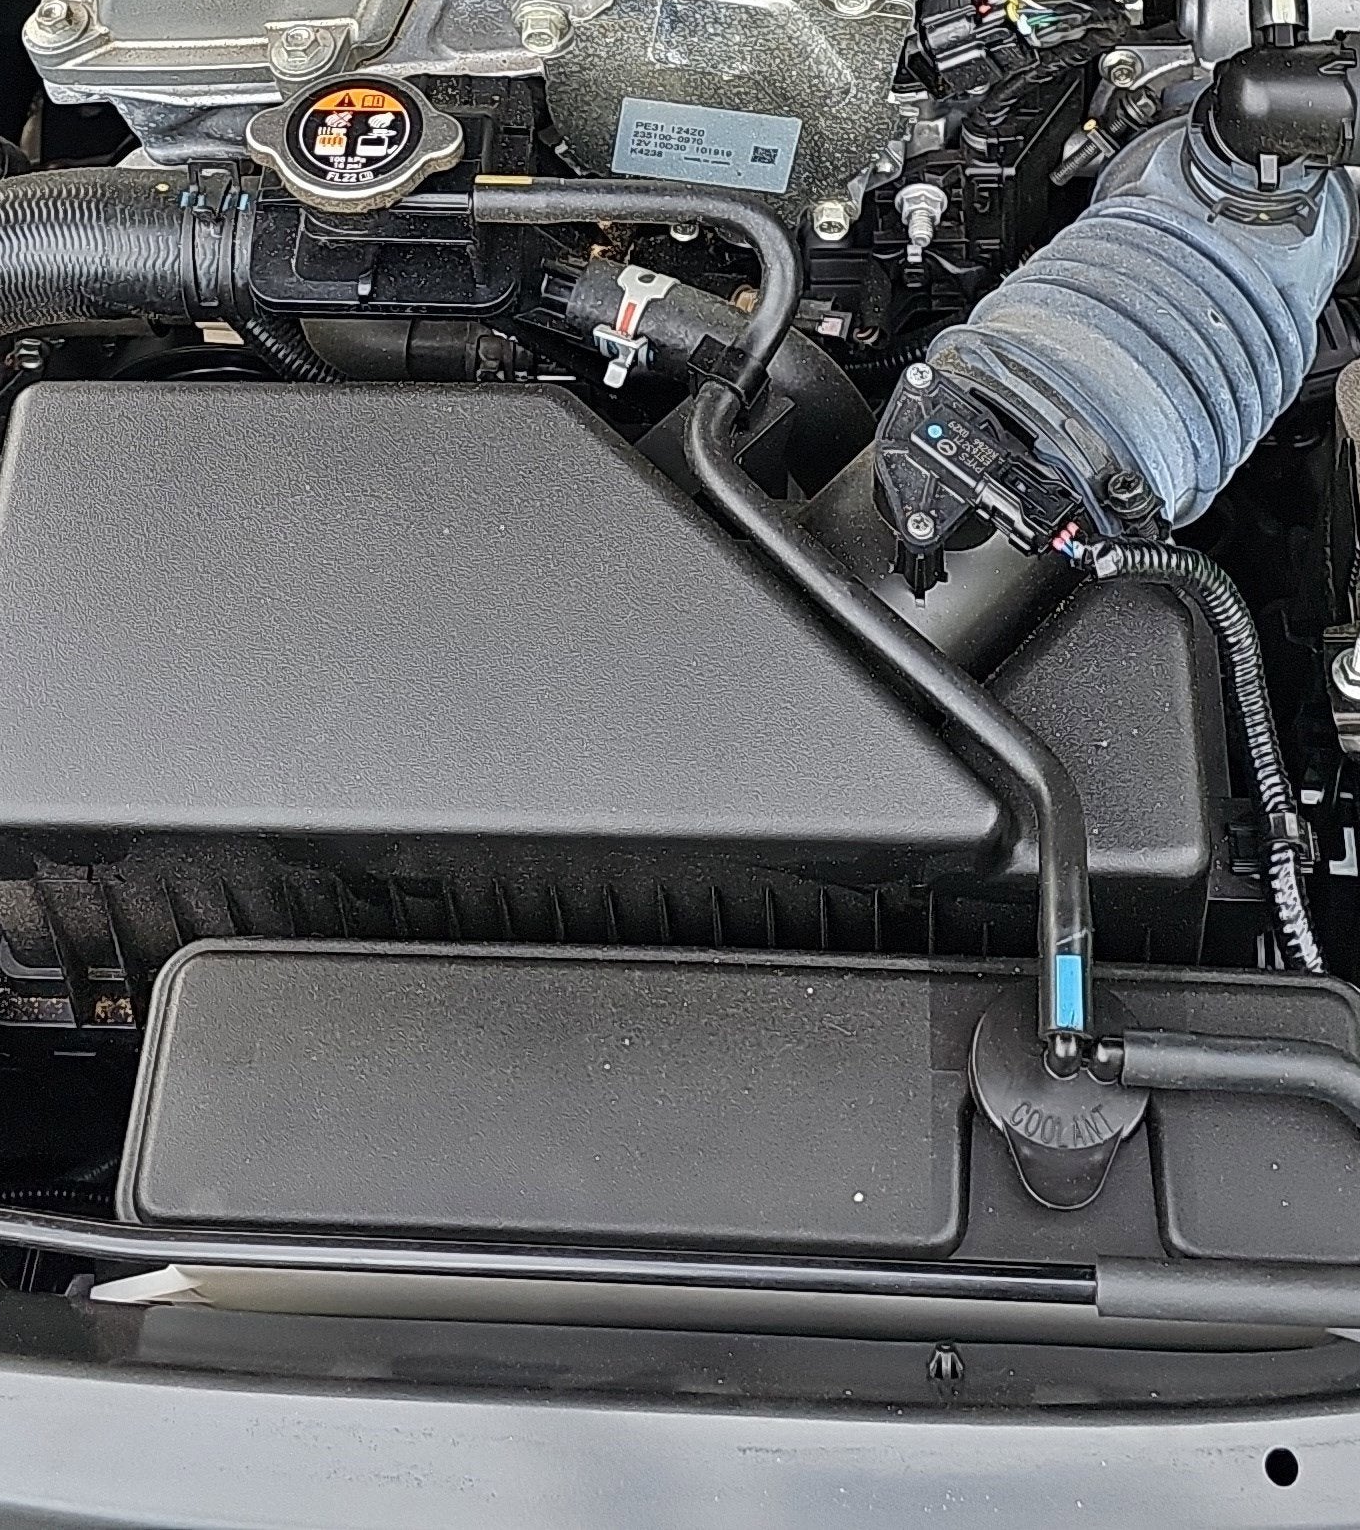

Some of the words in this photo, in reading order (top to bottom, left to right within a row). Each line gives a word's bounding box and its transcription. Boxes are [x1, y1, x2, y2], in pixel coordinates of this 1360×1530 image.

[633, 131, 703, 145] 235100-0970
[326, 172, 357, 182] FL22
[1010, 1101, 1114, 1149] COOLANT
